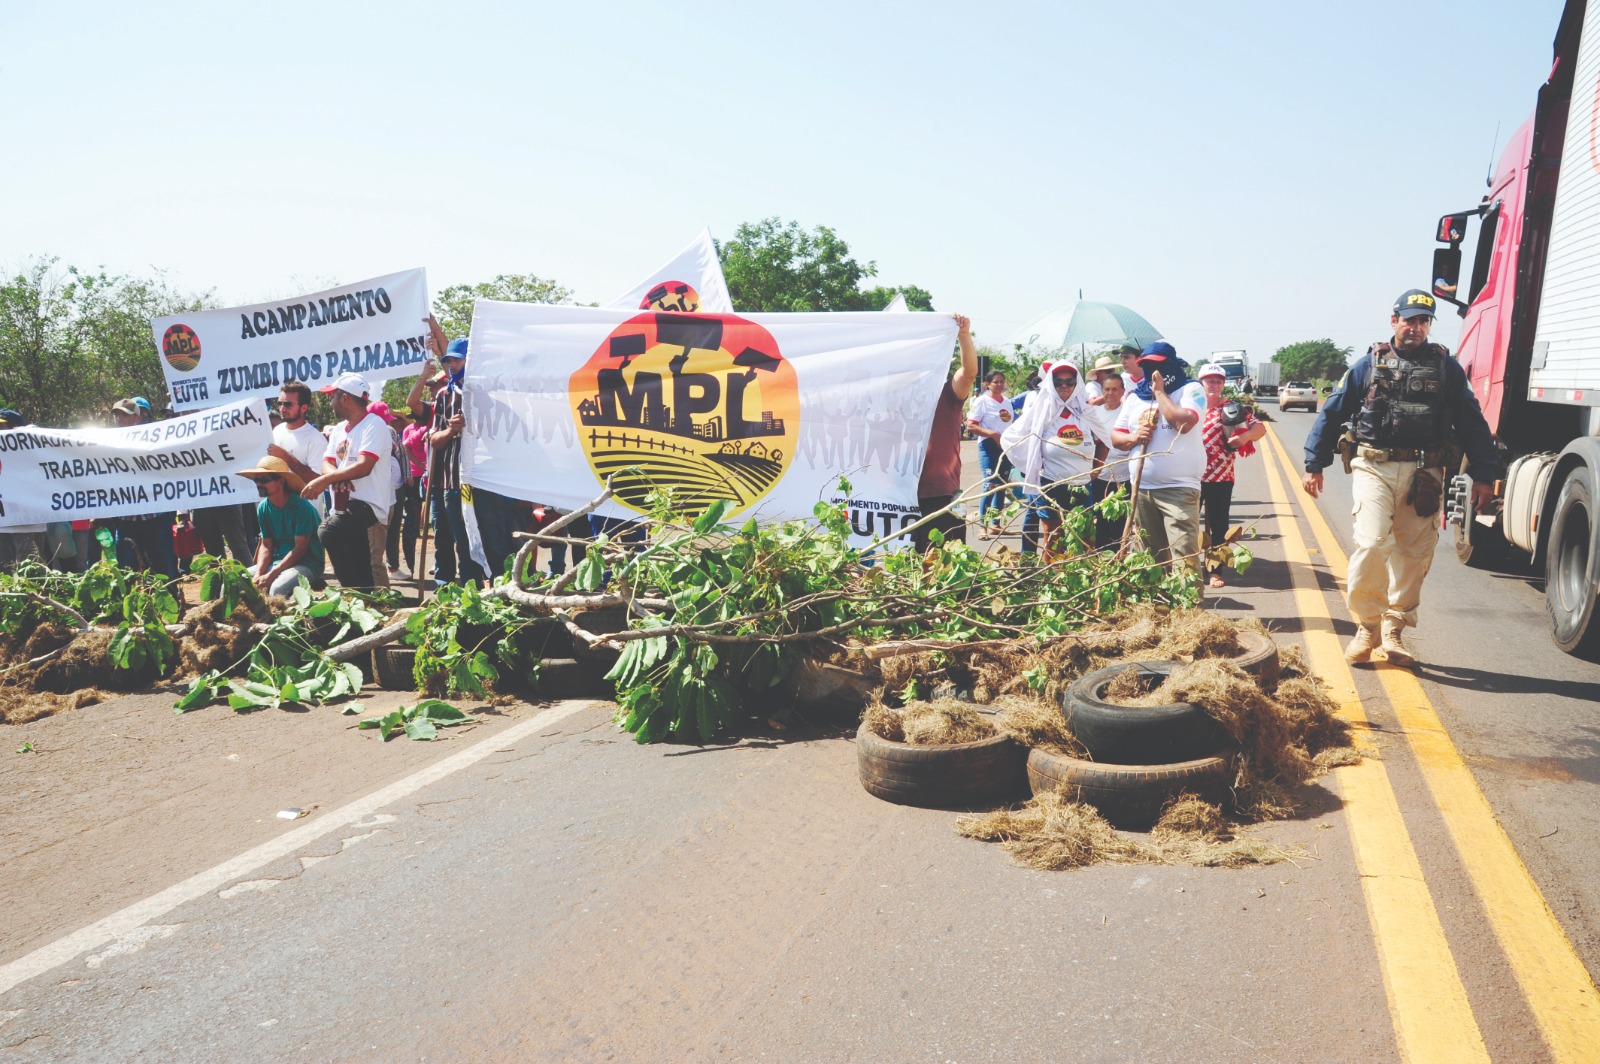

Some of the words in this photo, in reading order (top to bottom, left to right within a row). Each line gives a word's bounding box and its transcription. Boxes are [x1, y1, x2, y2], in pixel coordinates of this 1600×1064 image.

[241, 287, 392, 339] ACAMPAMENTO
[1407, 294, 1434, 307] PRF
[166, 337, 200, 355] MPL
[218, 360, 279, 394] ZUMBI
[283, 354, 322, 384] DOS
[173, 382, 208, 403] LUTA
[596, 368, 785, 443] MPL
[165, 419, 197, 440] POR
[203, 406, 262, 433] TERRA,
[39, 456, 136, 480] TRABALHO,
[133, 447, 215, 471] MORADIA
[218, 443, 235, 461] E
[51, 485, 149, 511] SOBERANIA
[153, 475, 236, 501] POPULAR.
[851, 510, 923, 542] UTA
